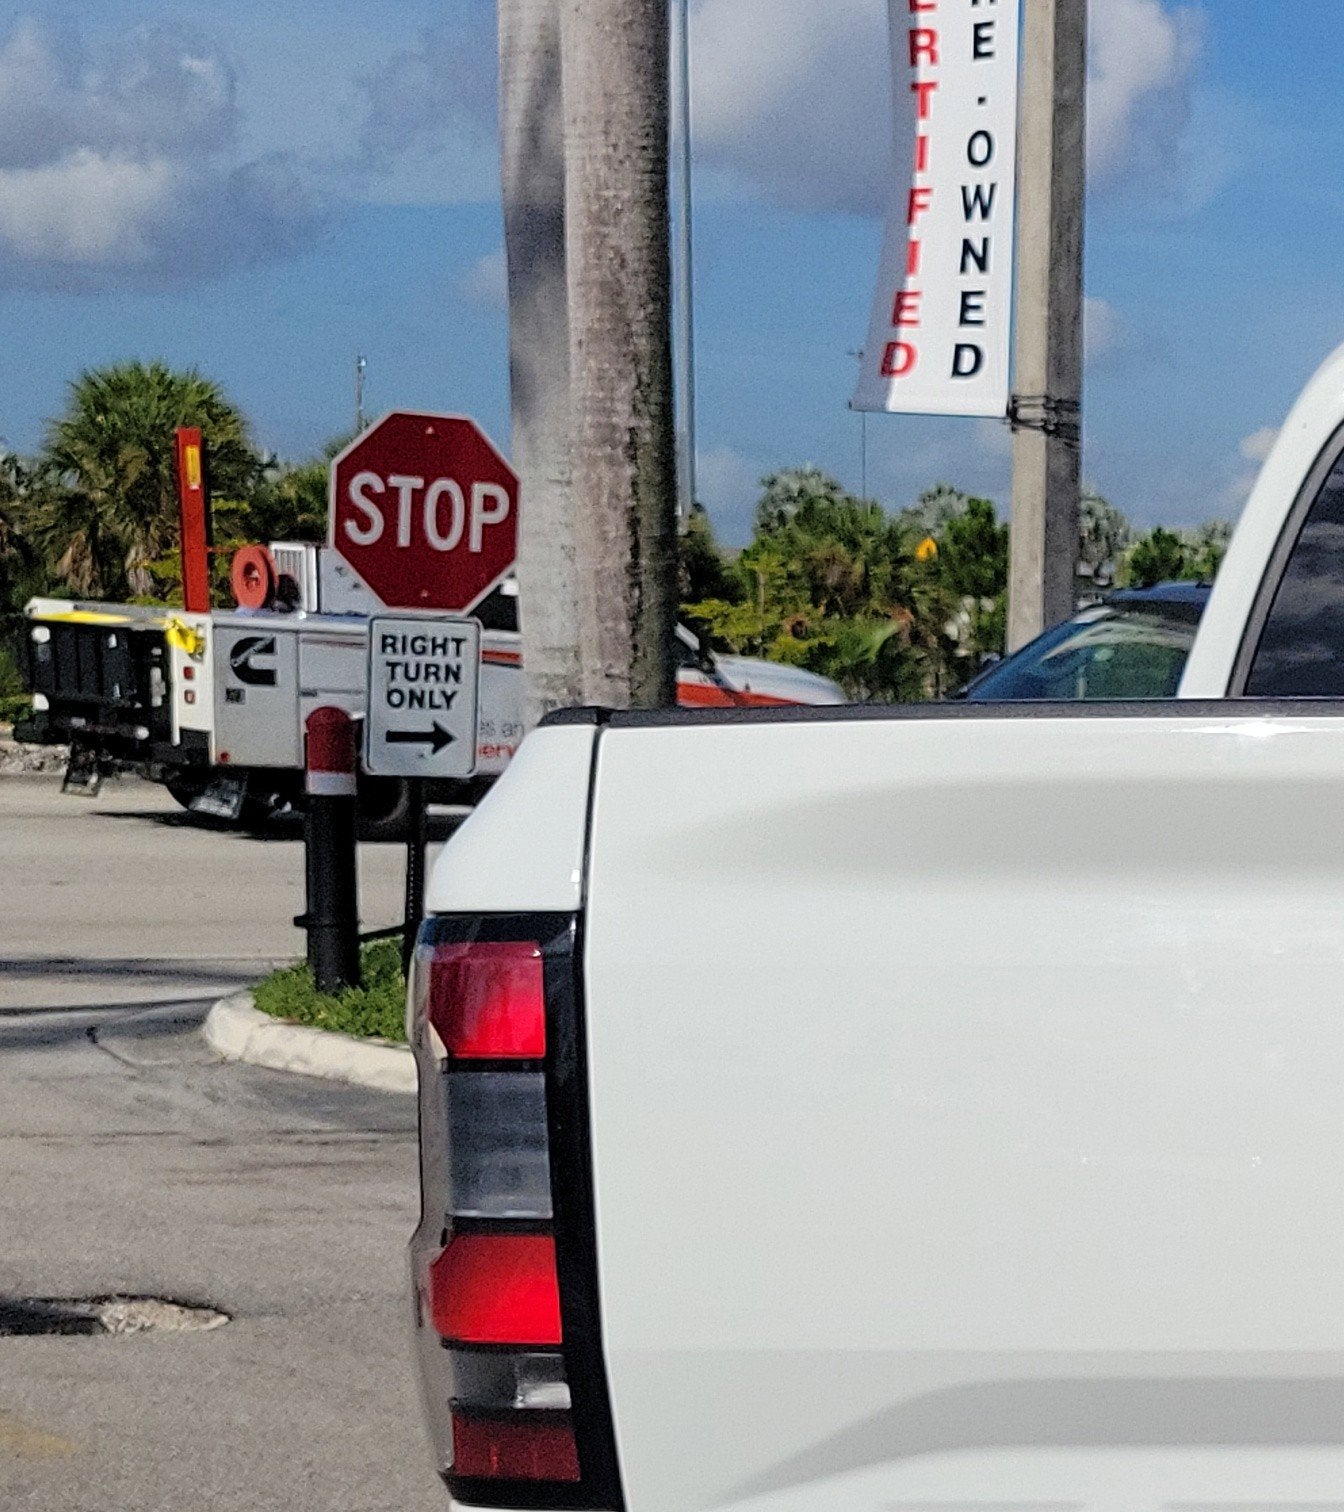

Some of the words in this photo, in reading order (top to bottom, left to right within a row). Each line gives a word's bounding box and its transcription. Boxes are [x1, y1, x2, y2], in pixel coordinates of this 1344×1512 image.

[343, 470, 510, 553] STOP
[381, 634, 467, 657] RIGHT
[386, 661, 462, 684] TURN
[387, 688, 458, 711] ONLY
